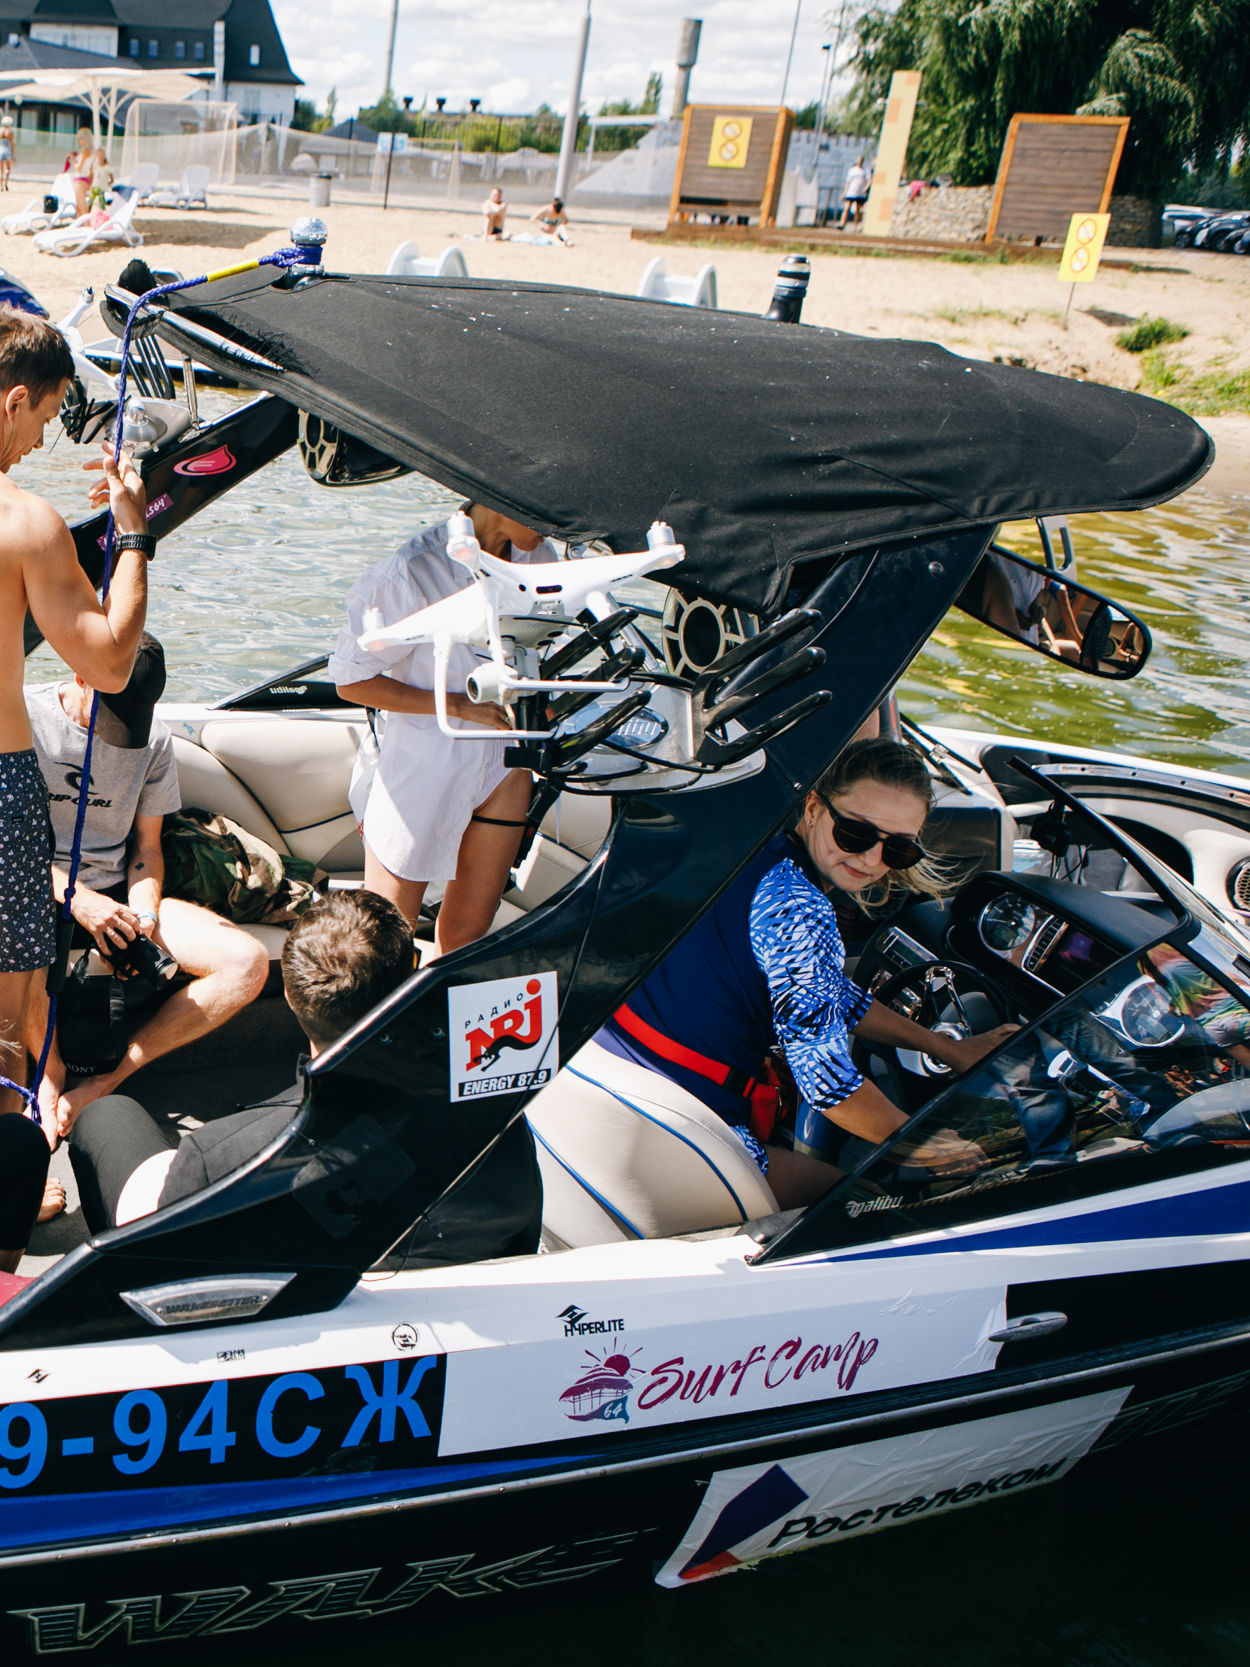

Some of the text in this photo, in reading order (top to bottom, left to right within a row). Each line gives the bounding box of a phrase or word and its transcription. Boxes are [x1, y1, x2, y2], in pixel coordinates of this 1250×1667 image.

[464, 992, 524, 1029] РАДИО
[465, 978, 542, 1072] NRJ
[462, 1070, 548, 1096] ENERGY 87.9
[846, 1195, 903, 1218] malibu
[564, 1318, 625, 1337] HYPERLITE
[637, 1331, 879, 1410] Surf Camp
[603, 1402, 624, 1419] 64
[766, 1457, 1068, 1548] Ростелеком
